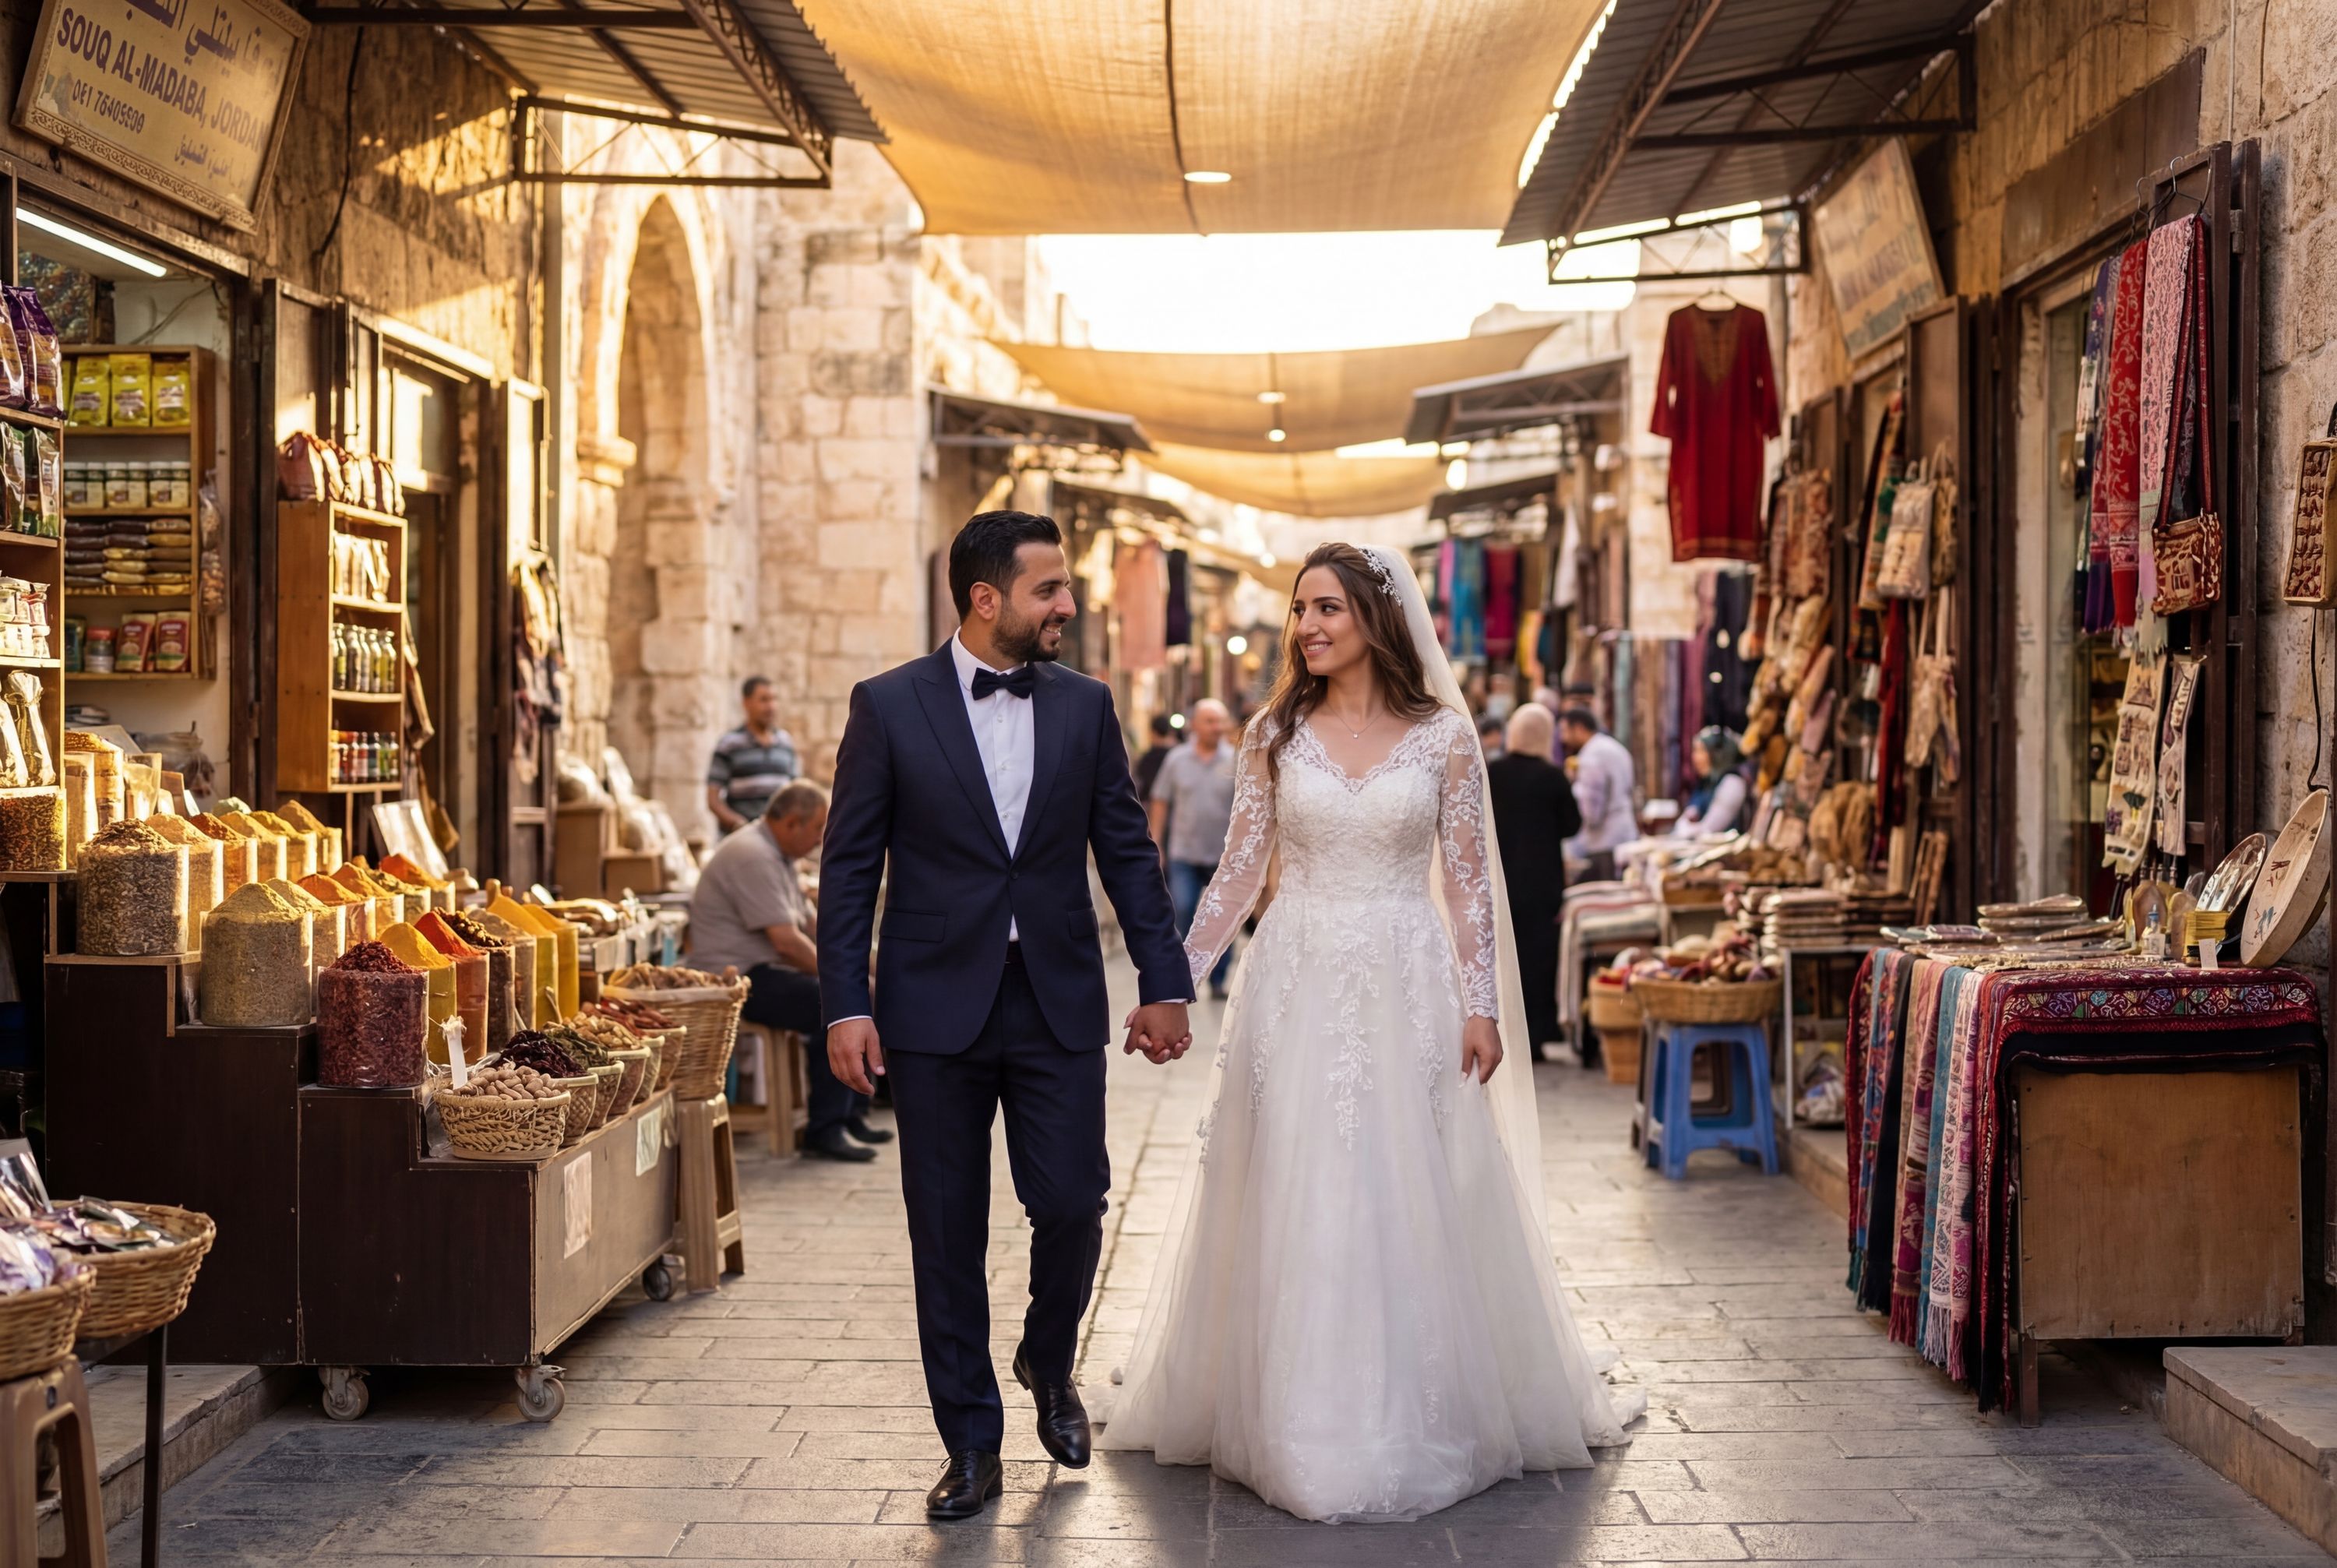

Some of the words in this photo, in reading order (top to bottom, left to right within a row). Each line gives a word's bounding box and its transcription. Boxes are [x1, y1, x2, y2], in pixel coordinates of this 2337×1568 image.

[58, 7, 112, 74] SOUQ
[111, 40, 206, 129] AL-MADABA,
[210, 97, 271, 153] JORDAN
